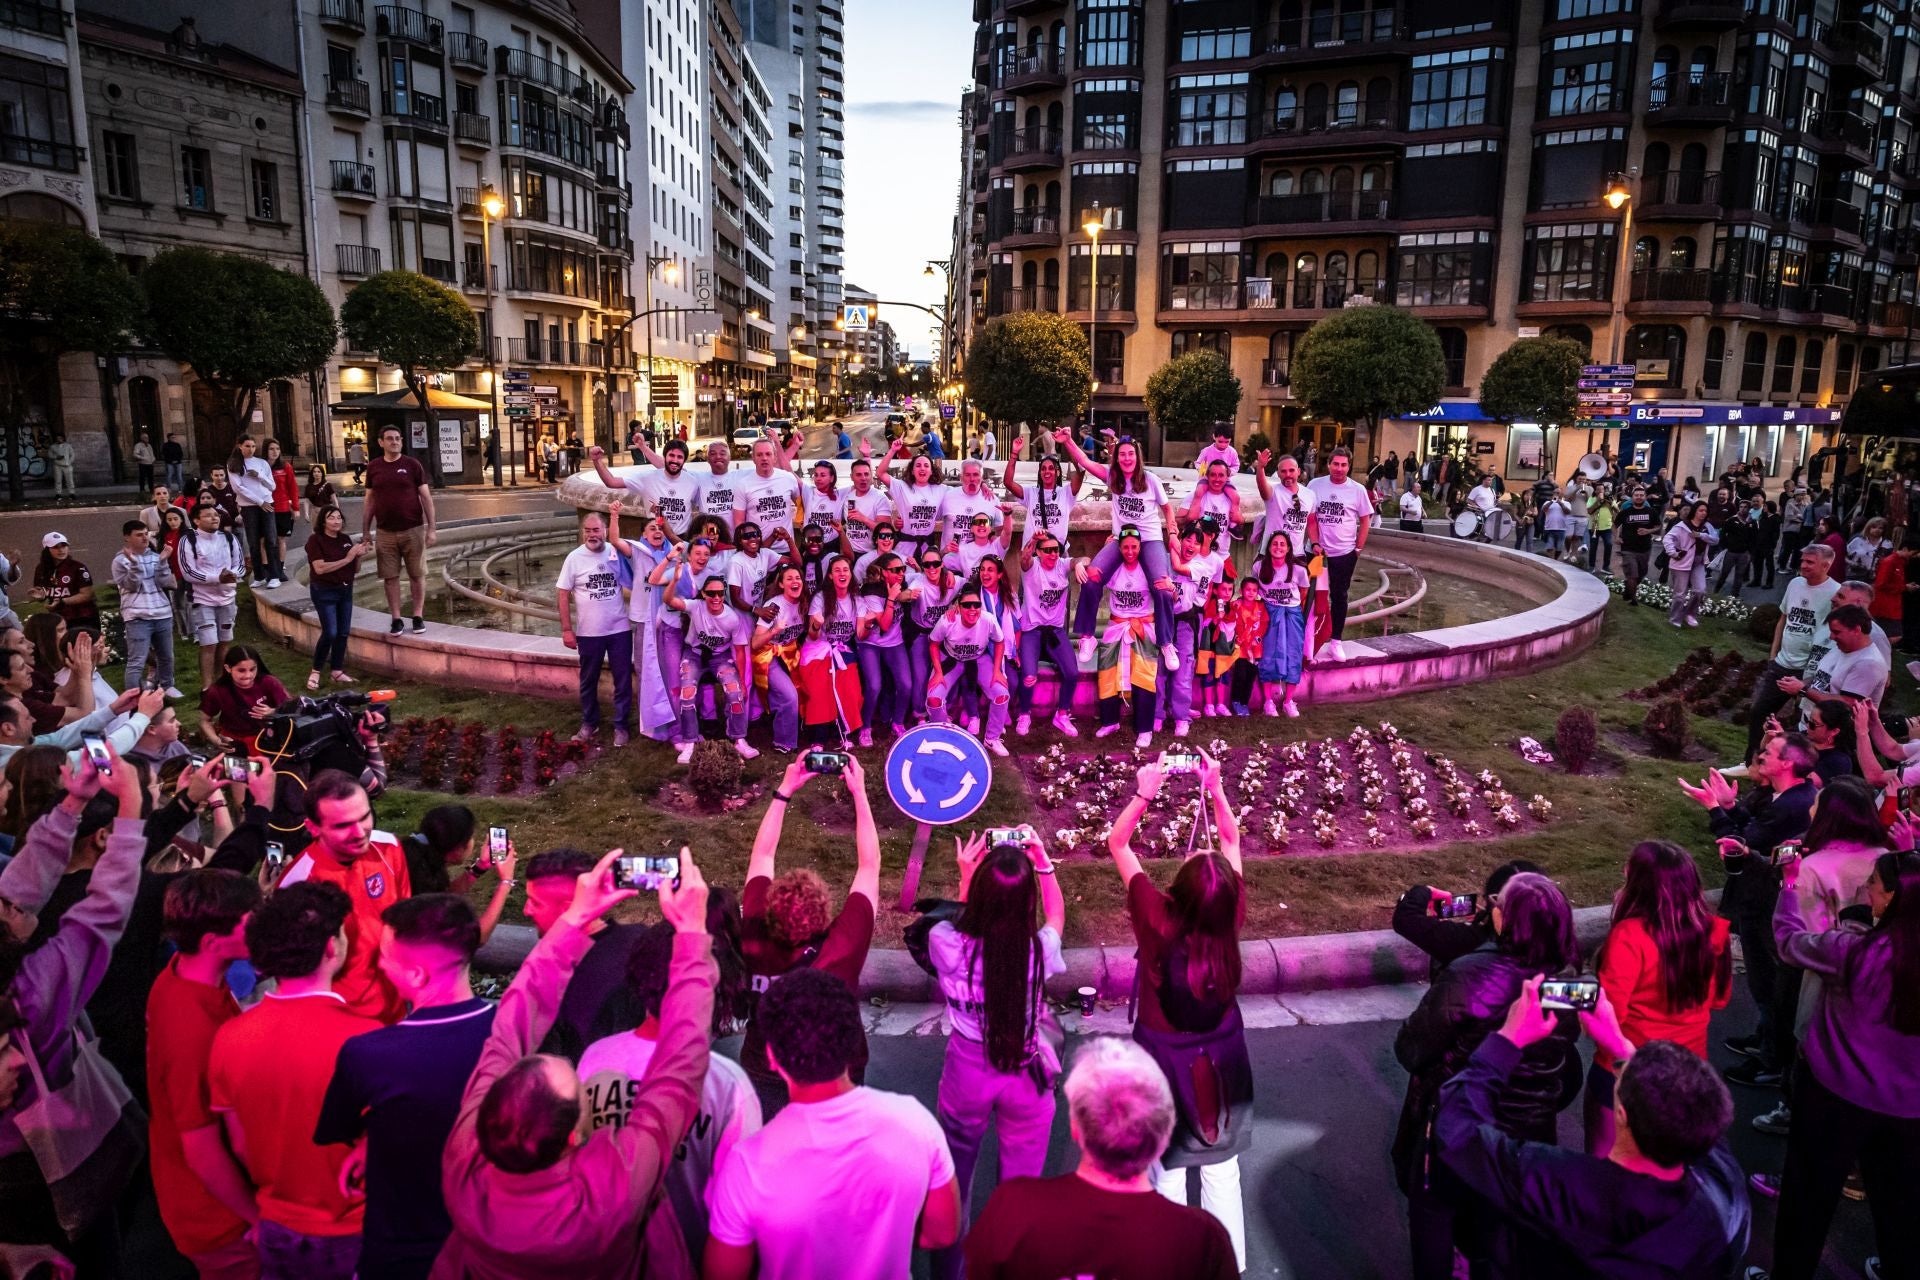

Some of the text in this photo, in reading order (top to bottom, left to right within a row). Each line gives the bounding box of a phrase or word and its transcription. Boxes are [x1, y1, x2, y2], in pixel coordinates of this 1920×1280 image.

[1728, 409, 1742, 420] BBVA
[1783, 410, 1795, 420] BBVA
[709, 489, 733, 498] SOMOS
[659, 497, 685, 506] SOMOS
[758, 496, 784, 505] SOMOS
[1320, 500, 1344, 510] SOMOS
[912, 505, 937, 514] SOMOS
[810, 512, 834, 520] SOMOS
[588, 572, 615, 582] SOMOS
[43, 586, 71, 598] VISA
[1115, 590, 1142, 598] SOMOS
